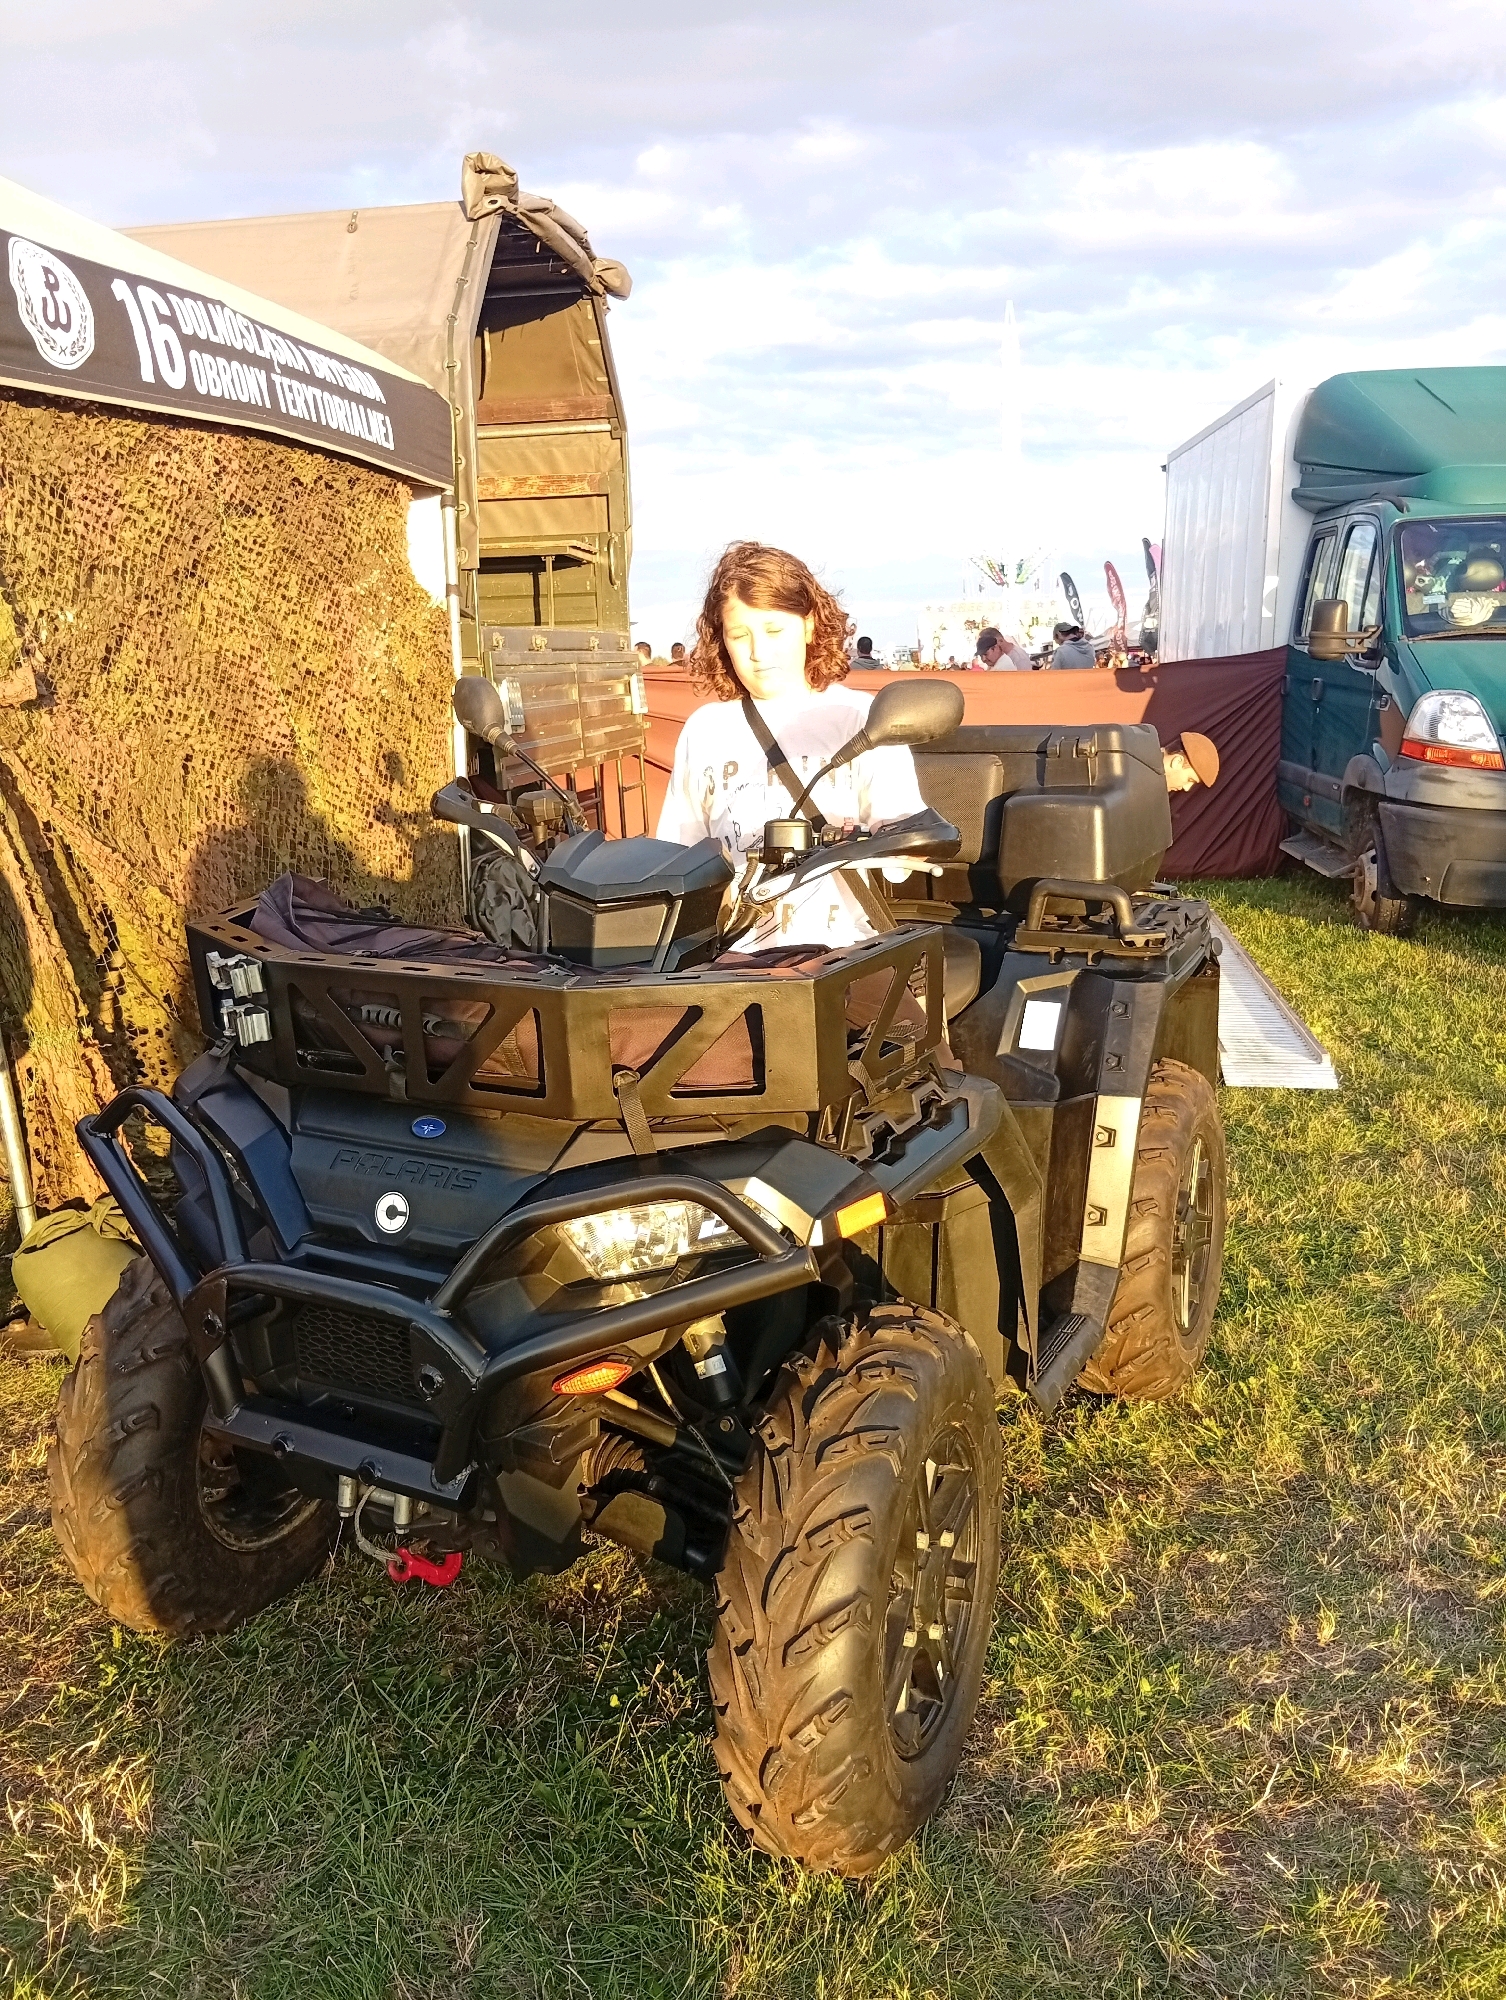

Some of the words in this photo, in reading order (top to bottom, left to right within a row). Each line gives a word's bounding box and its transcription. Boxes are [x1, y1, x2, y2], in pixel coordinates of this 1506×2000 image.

[110, 278, 187, 390] 16
[189, 349, 272, 409] OBRONY
[271, 372, 395, 451] TERYTORIALNEJ
[299, 345, 387, 405] BRYGADA
[329, 1148, 482, 1191] POLARIS
